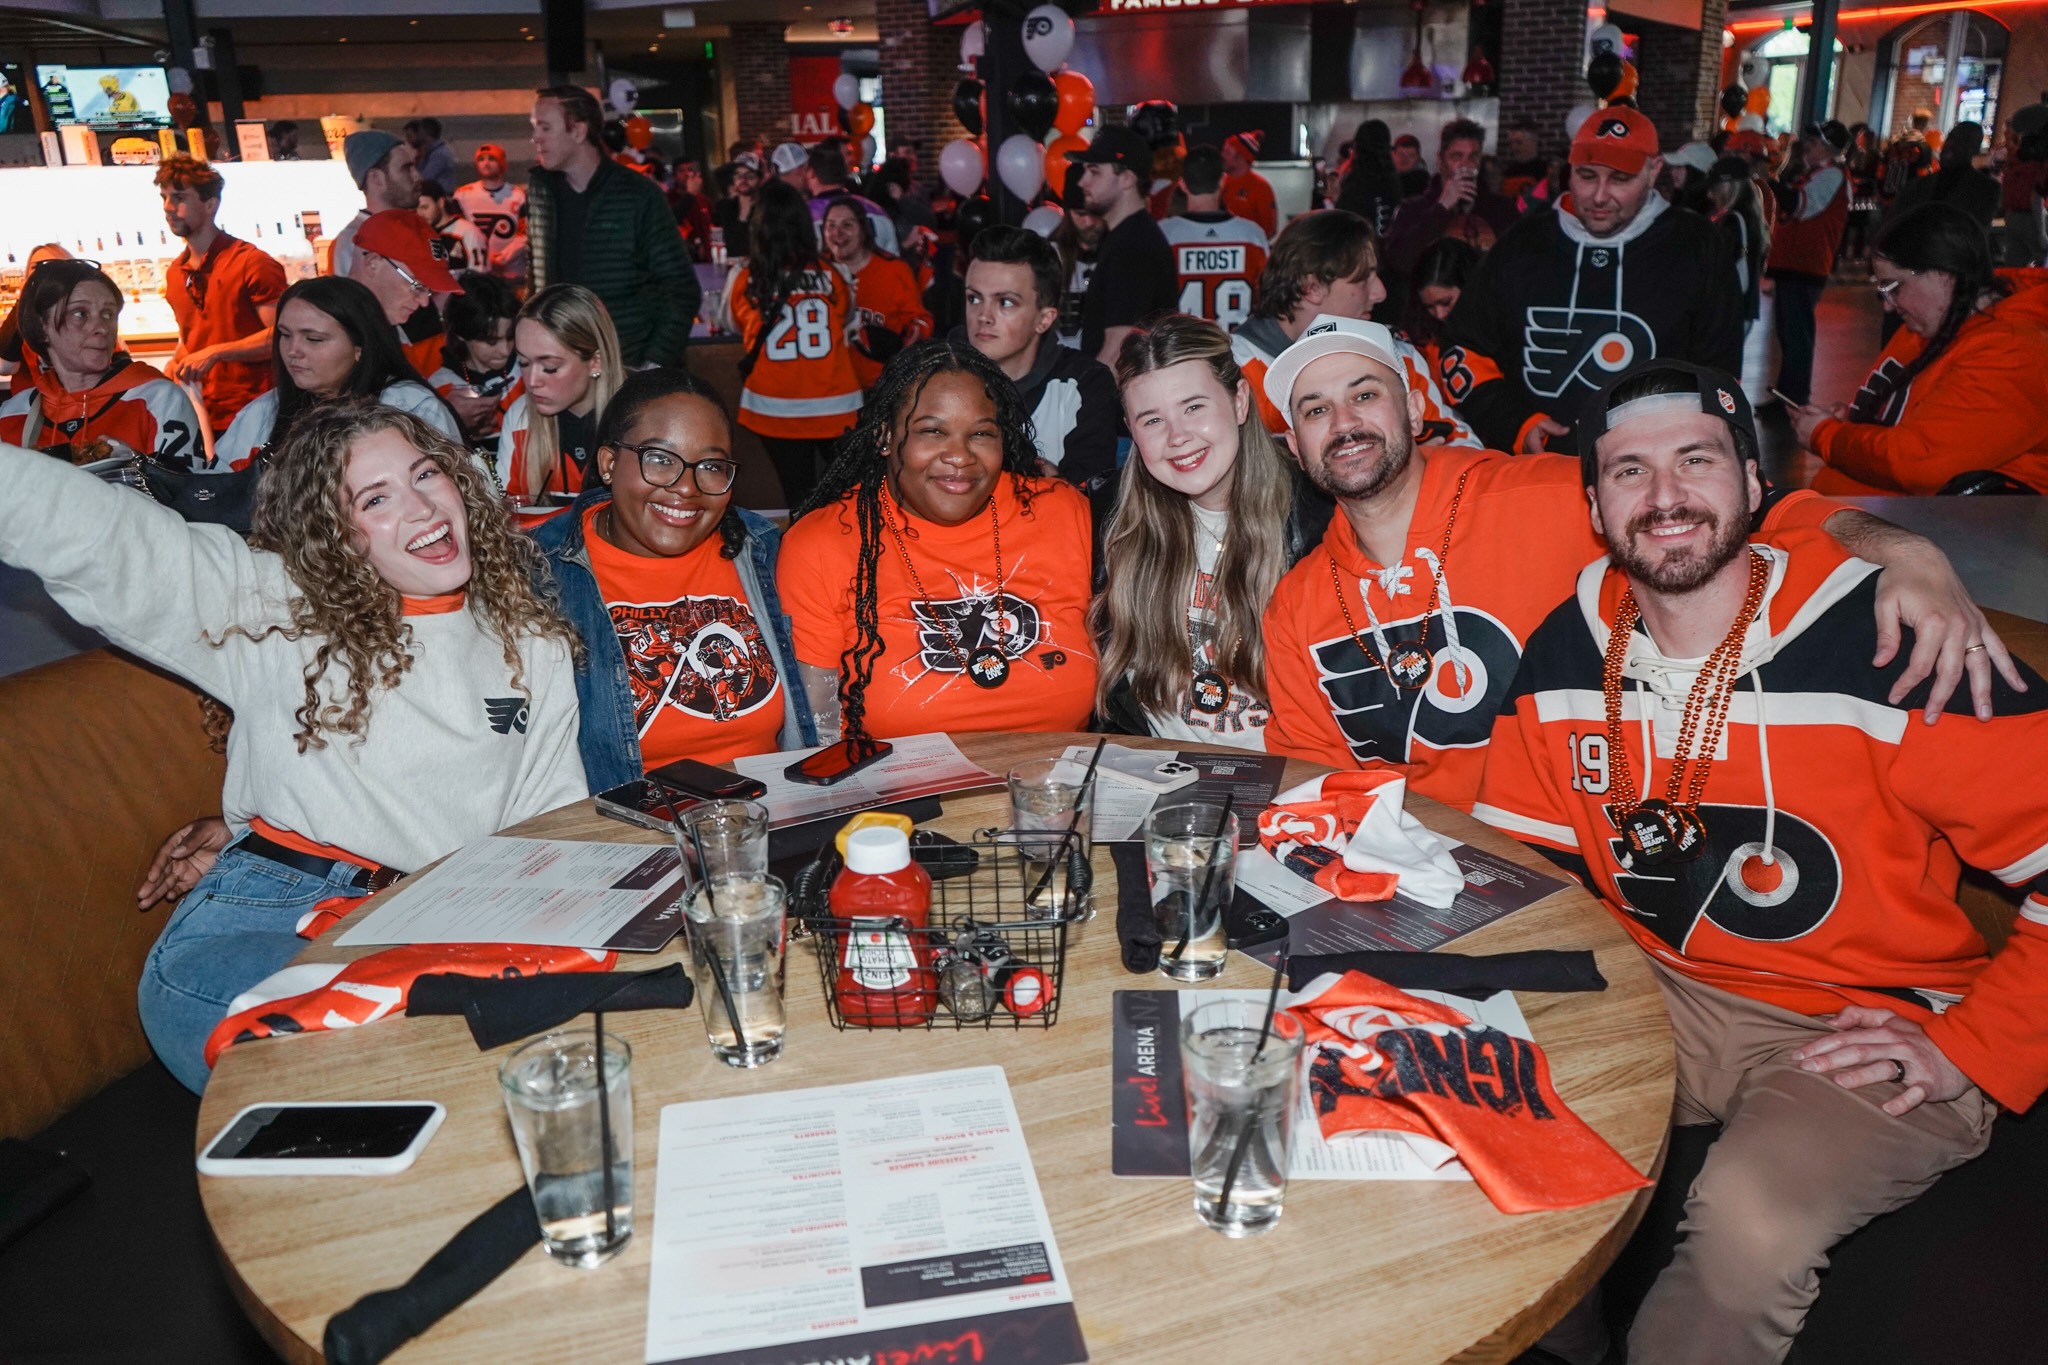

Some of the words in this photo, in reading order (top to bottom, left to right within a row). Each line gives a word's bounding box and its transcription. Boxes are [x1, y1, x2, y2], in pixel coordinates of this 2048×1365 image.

[1184, 249, 1239, 271] FROST
[1178, 279, 1253, 334] 48
[765, 297, 832, 362] 28
[611, 607, 671, 620] PHILLY
[1568, 732, 1610, 795] 19
[1637, 824, 1659, 837] GAME
[1639, 833, 1654, 843] DAY
[860, 955, 898, 965] TOMATO
[1136, 1026, 1157, 1076] ARENA
